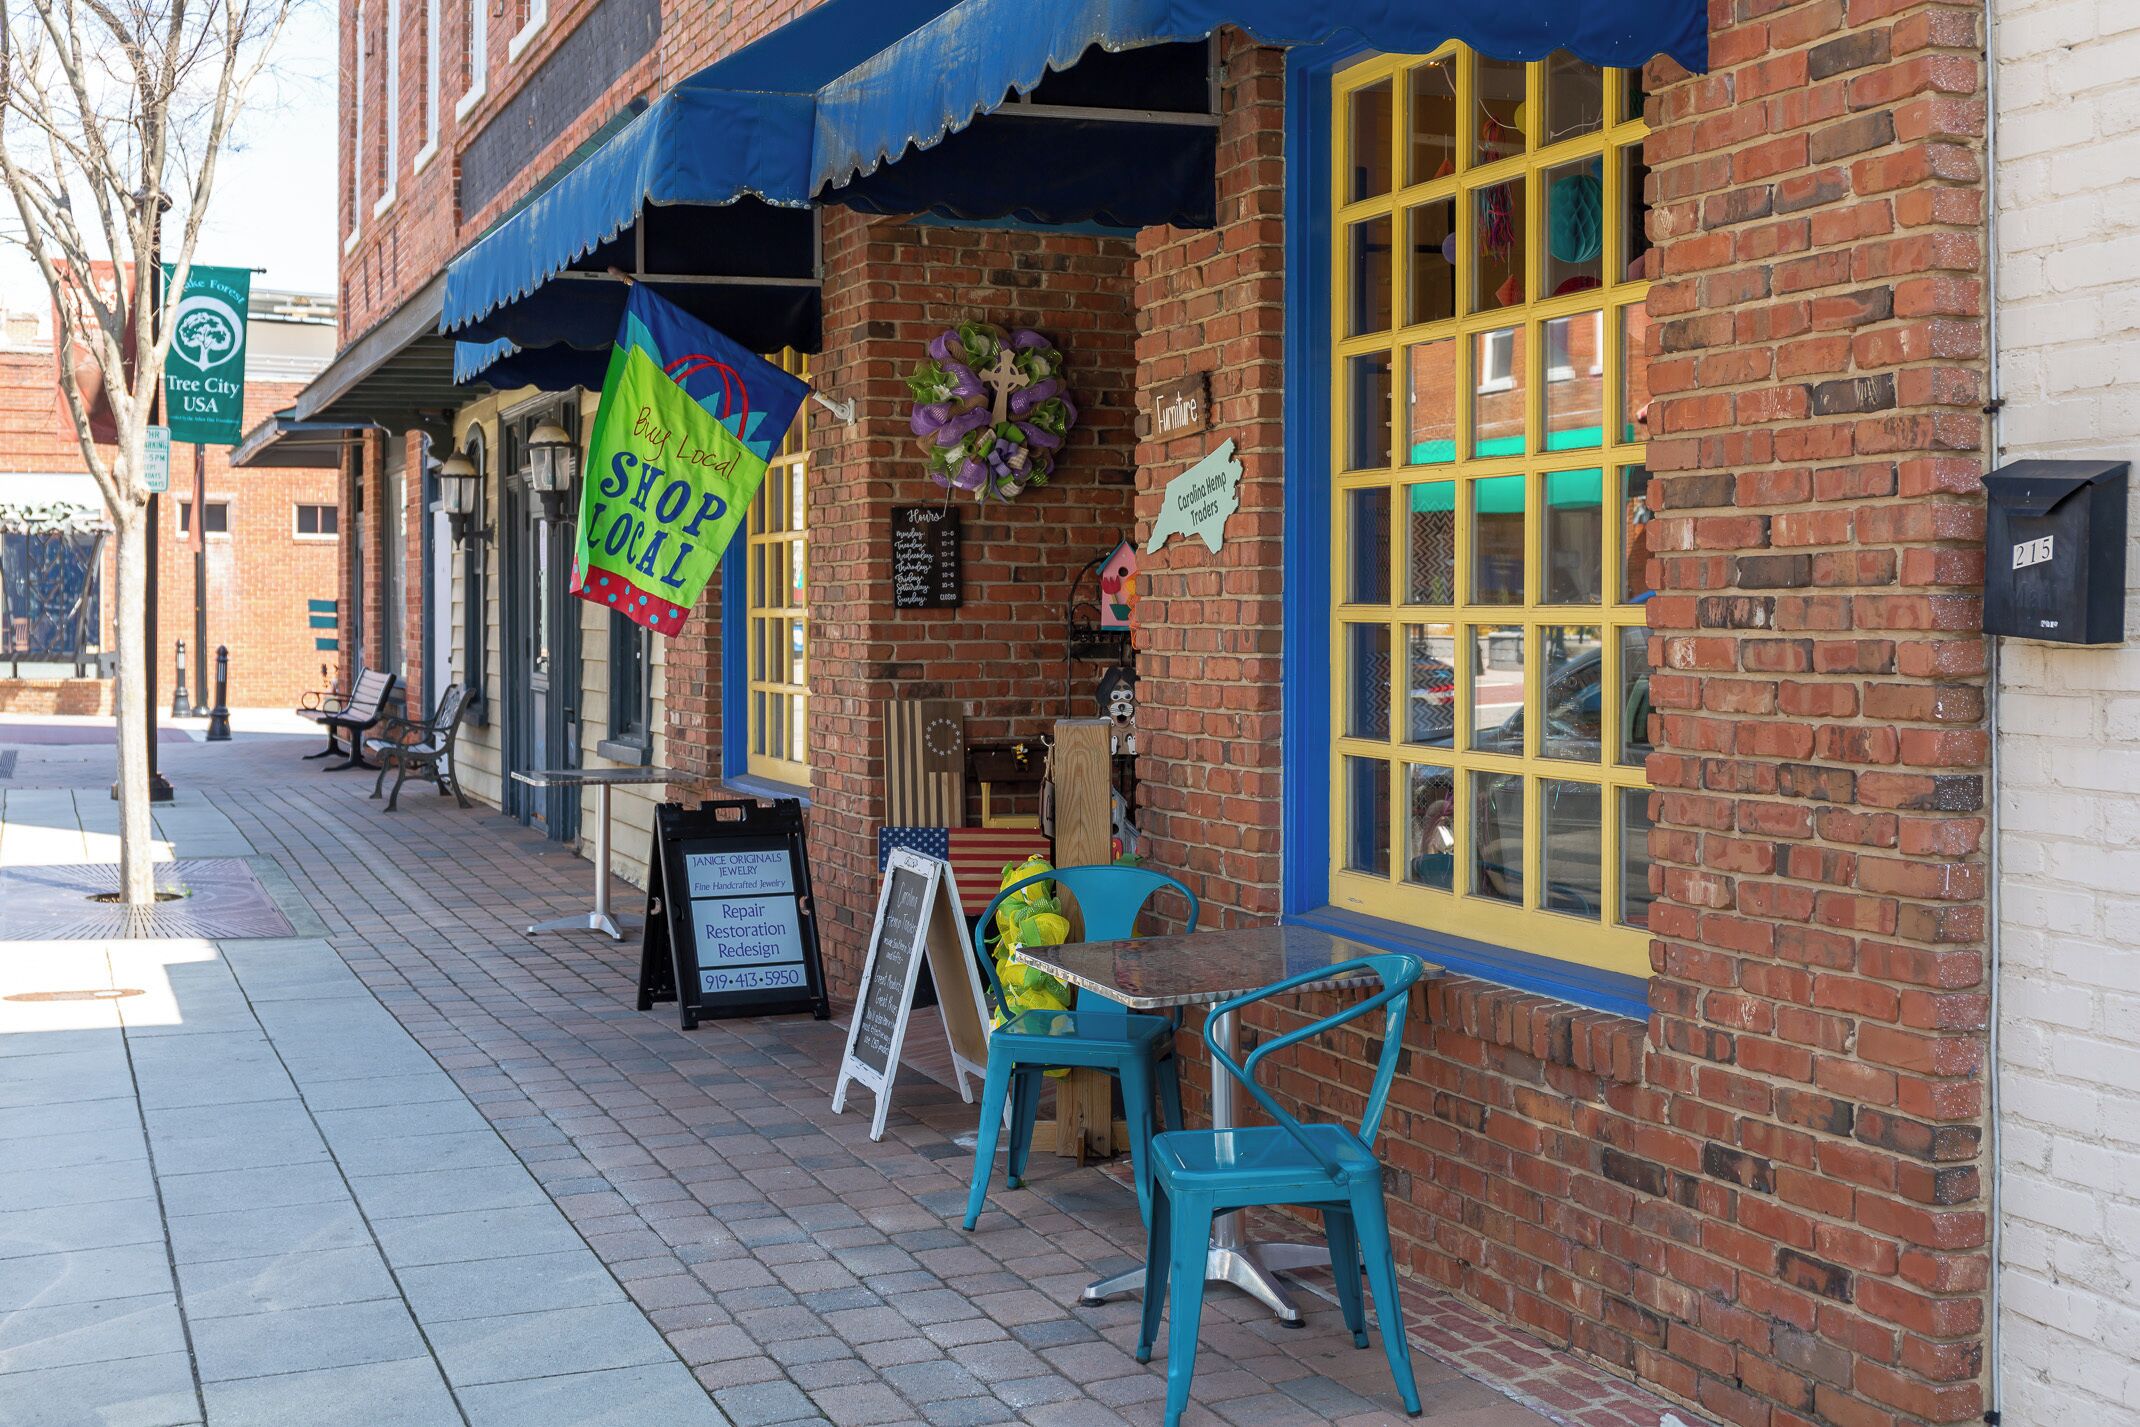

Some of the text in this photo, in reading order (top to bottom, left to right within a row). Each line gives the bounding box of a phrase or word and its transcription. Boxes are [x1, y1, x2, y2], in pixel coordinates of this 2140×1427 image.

[210, 279, 245, 304] Forest
[167, 374, 240, 398] Tree City
[184, 396, 219, 413] USA
[1156, 390, 1198, 434] Furniture
[633, 406, 741, 480] Buy Local
[600, 451, 728, 538] SHOP
[1177, 472, 1227, 511] Carolina Hemp
[907, 509, 942, 524] Hours
[1190, 500, 1219, 526] Traders
[588, 502, 695, 589] LOCAL
[894, 538, 926, 550] Tuesday
[2016, 538, 2050, 566] 215
[896, 549, 934, 563] Wednesday
[895, 560, 932, 574] Thursday
[895, 572, 924, 584] Friday
[896, 583, 930, 594] Saturday
[896, 592, 927, 606] Sunday
[692, 853, 782, 867] JANICE ORIGINALS
[718, 865, 758, 877] JEWELRY
[713, 880, 757, 890] Handcrafted
[759, 879, 786, 889] Jewelry
[722, 903, 765, 921] Repair
[705, 922, 786, 939] Restoration
[718, 942, 780, 958] Redesign
